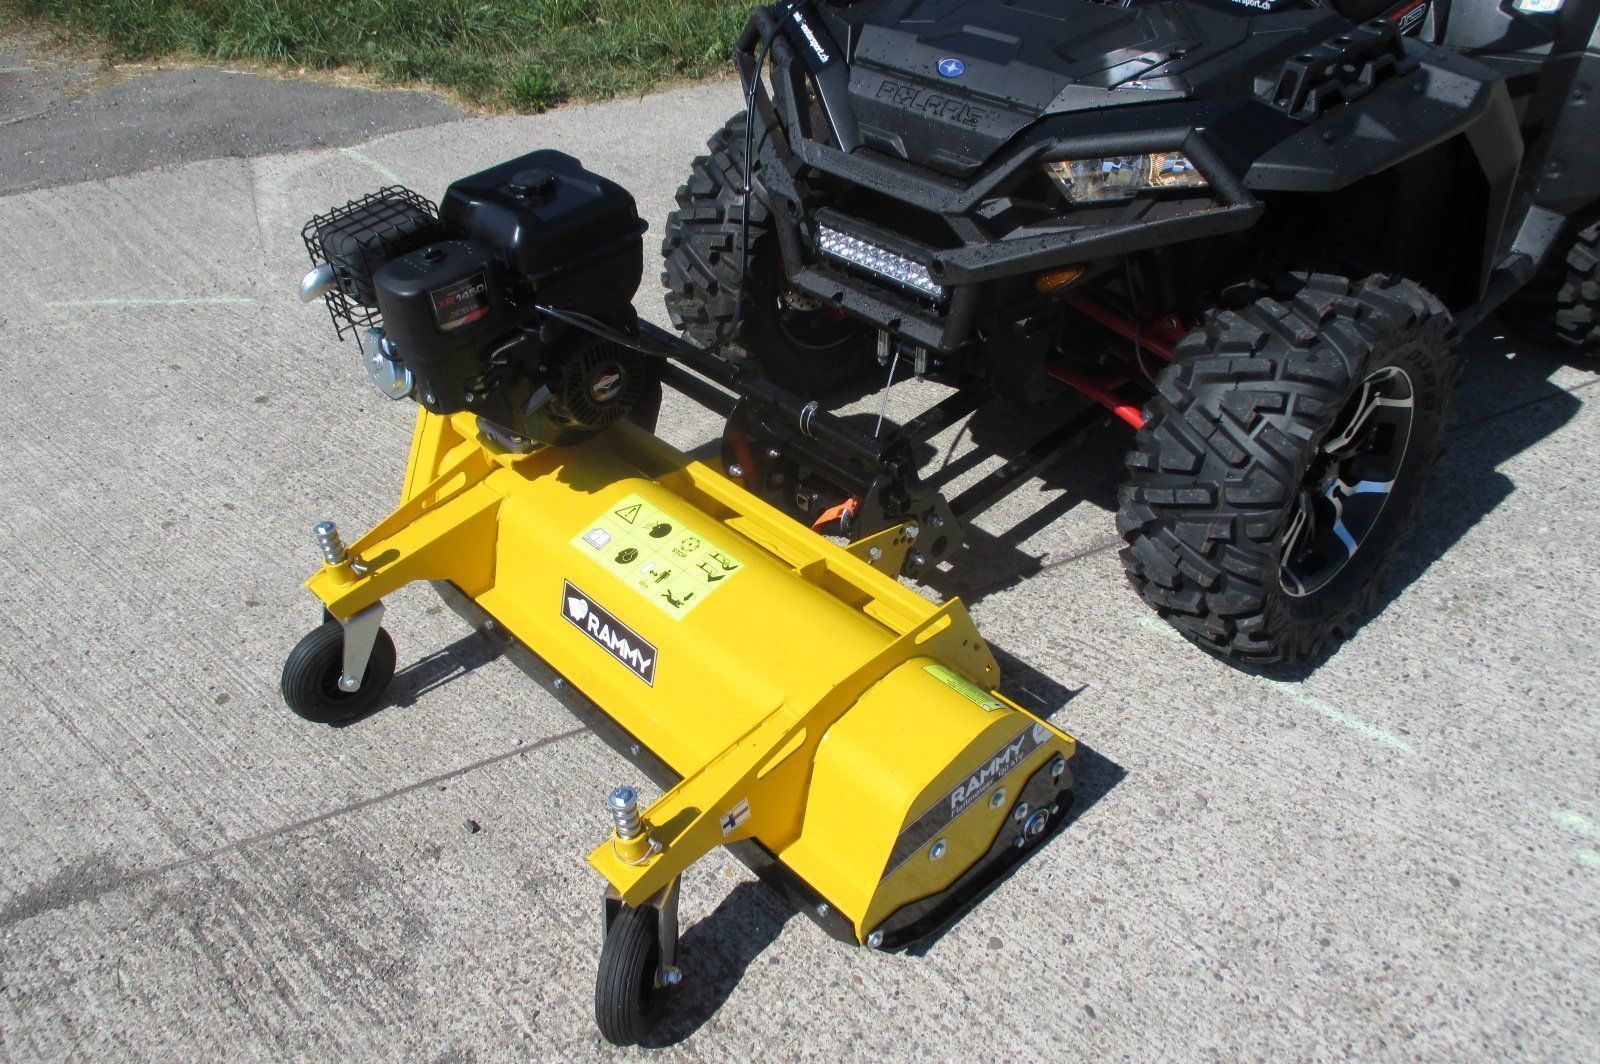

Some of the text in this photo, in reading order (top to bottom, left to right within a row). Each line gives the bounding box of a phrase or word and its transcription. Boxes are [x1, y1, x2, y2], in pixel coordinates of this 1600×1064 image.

[876, 80, 987, 127] POLARIS
[671, 547, 687, 559] STOP
[587, 611, 652, 674] RAMMY
[951, 733, 1026, 810] RAMMY
